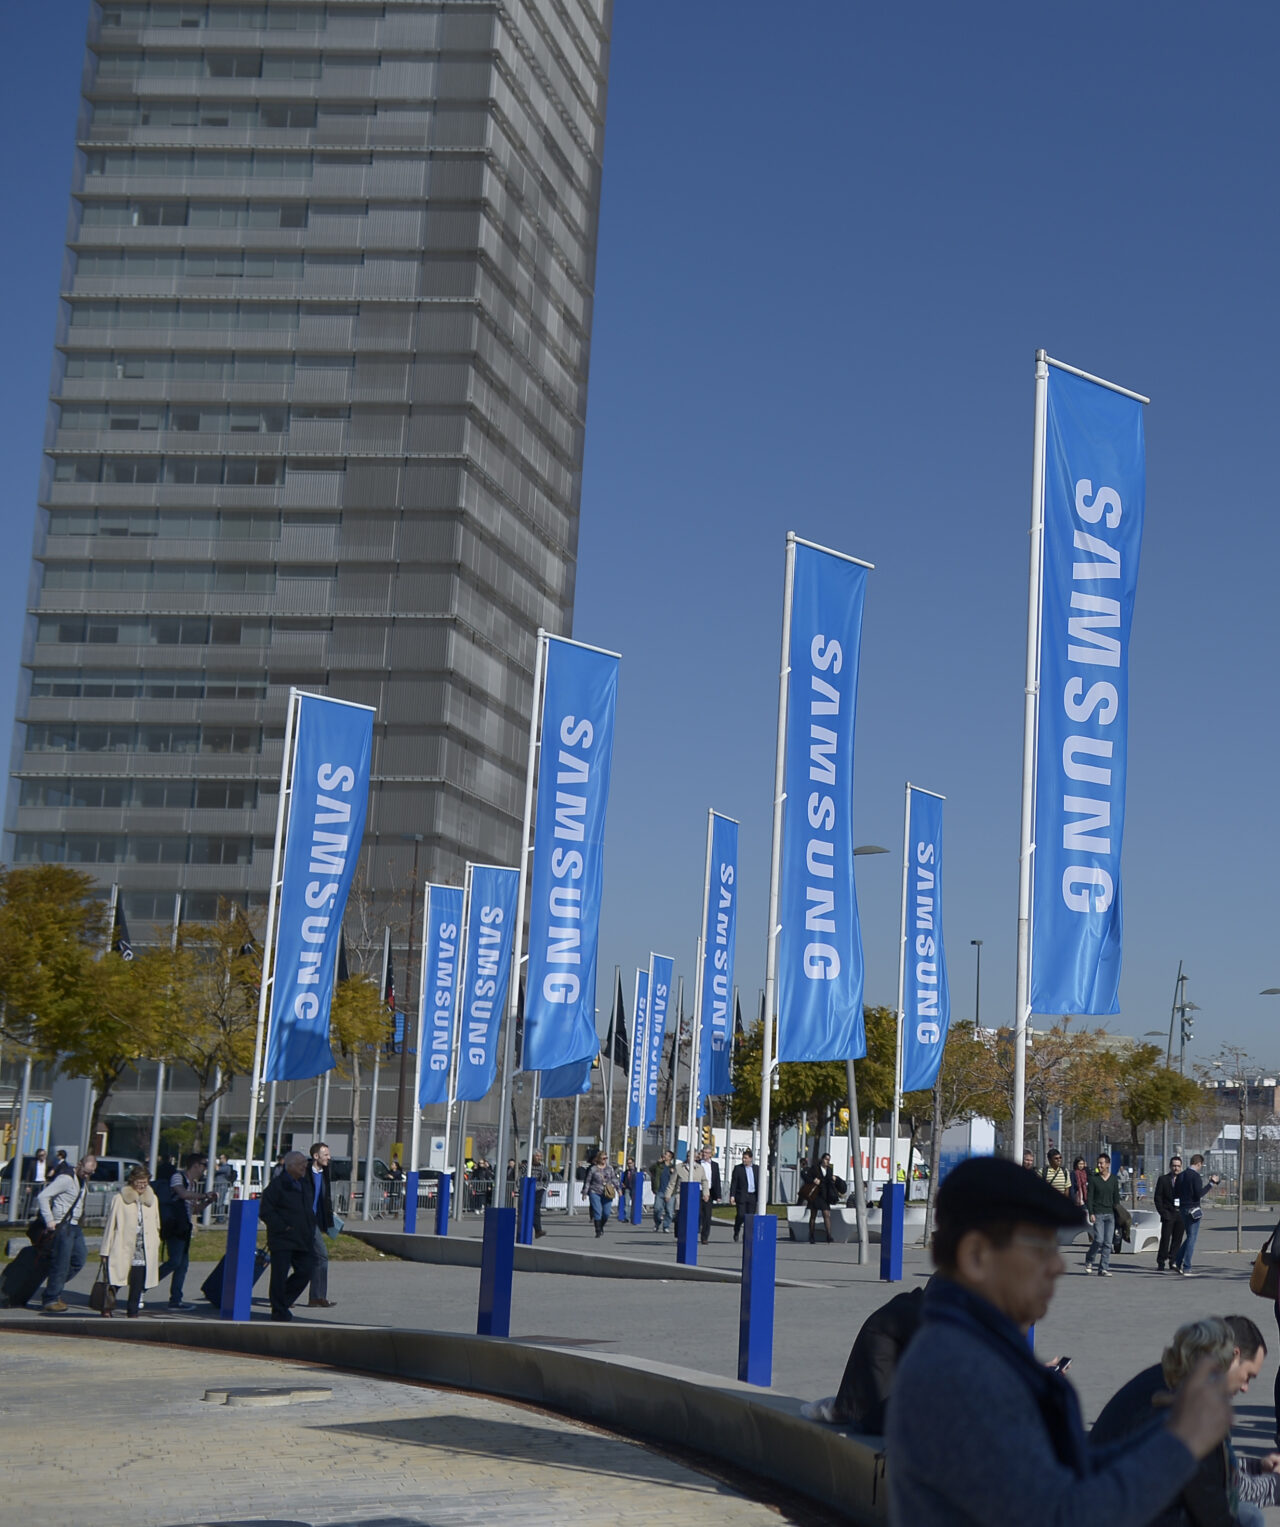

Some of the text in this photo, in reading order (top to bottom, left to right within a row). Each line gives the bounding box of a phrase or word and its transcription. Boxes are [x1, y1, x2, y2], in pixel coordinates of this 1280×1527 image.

[803, 634, 844, 981] SAMSUNG
[1062, 478, 1123, 913] SAMSUNG
[293, 762, 355, 1020] SAMSUNG
[543, 715, 594, 1005] SAMSUNG
[711, 862, 734, 1052] SAMSUNG
[915, 841, 941, 1044] SAMSUNG
[430, 922, 457, 1071] SAMSUNG
[468, 905, 504, 1066] SAMSUNG
